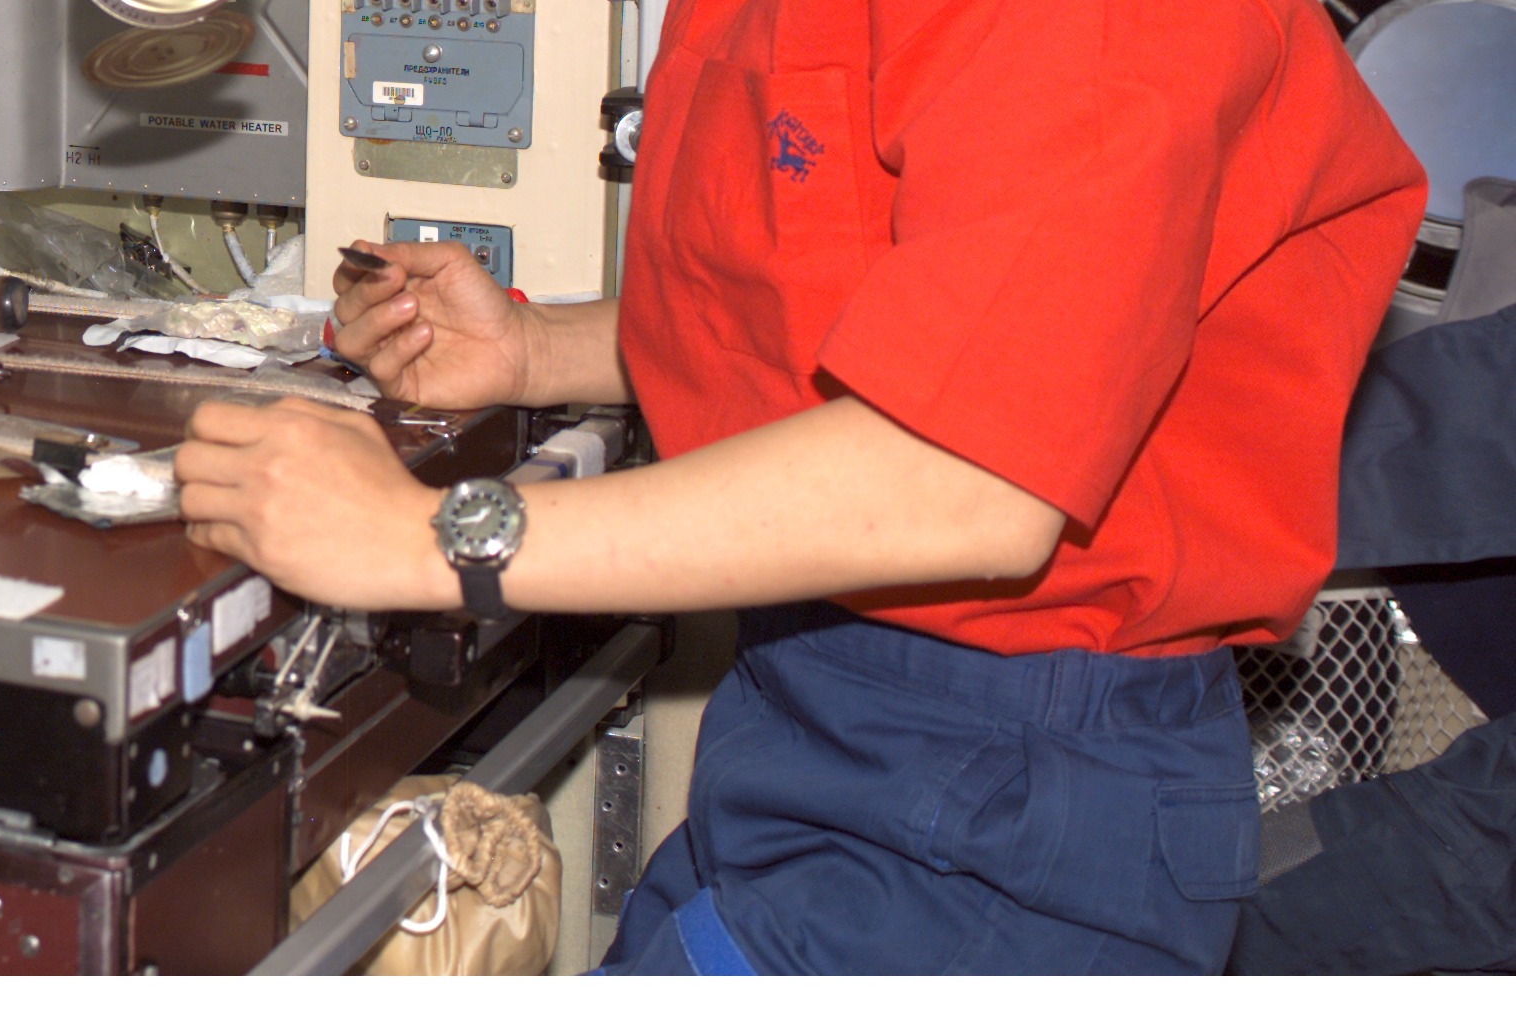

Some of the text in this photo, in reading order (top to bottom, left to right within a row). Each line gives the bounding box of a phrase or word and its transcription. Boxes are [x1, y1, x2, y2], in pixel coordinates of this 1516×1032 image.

[148, 116, 282, 133] POTABLE WATER HEATER
